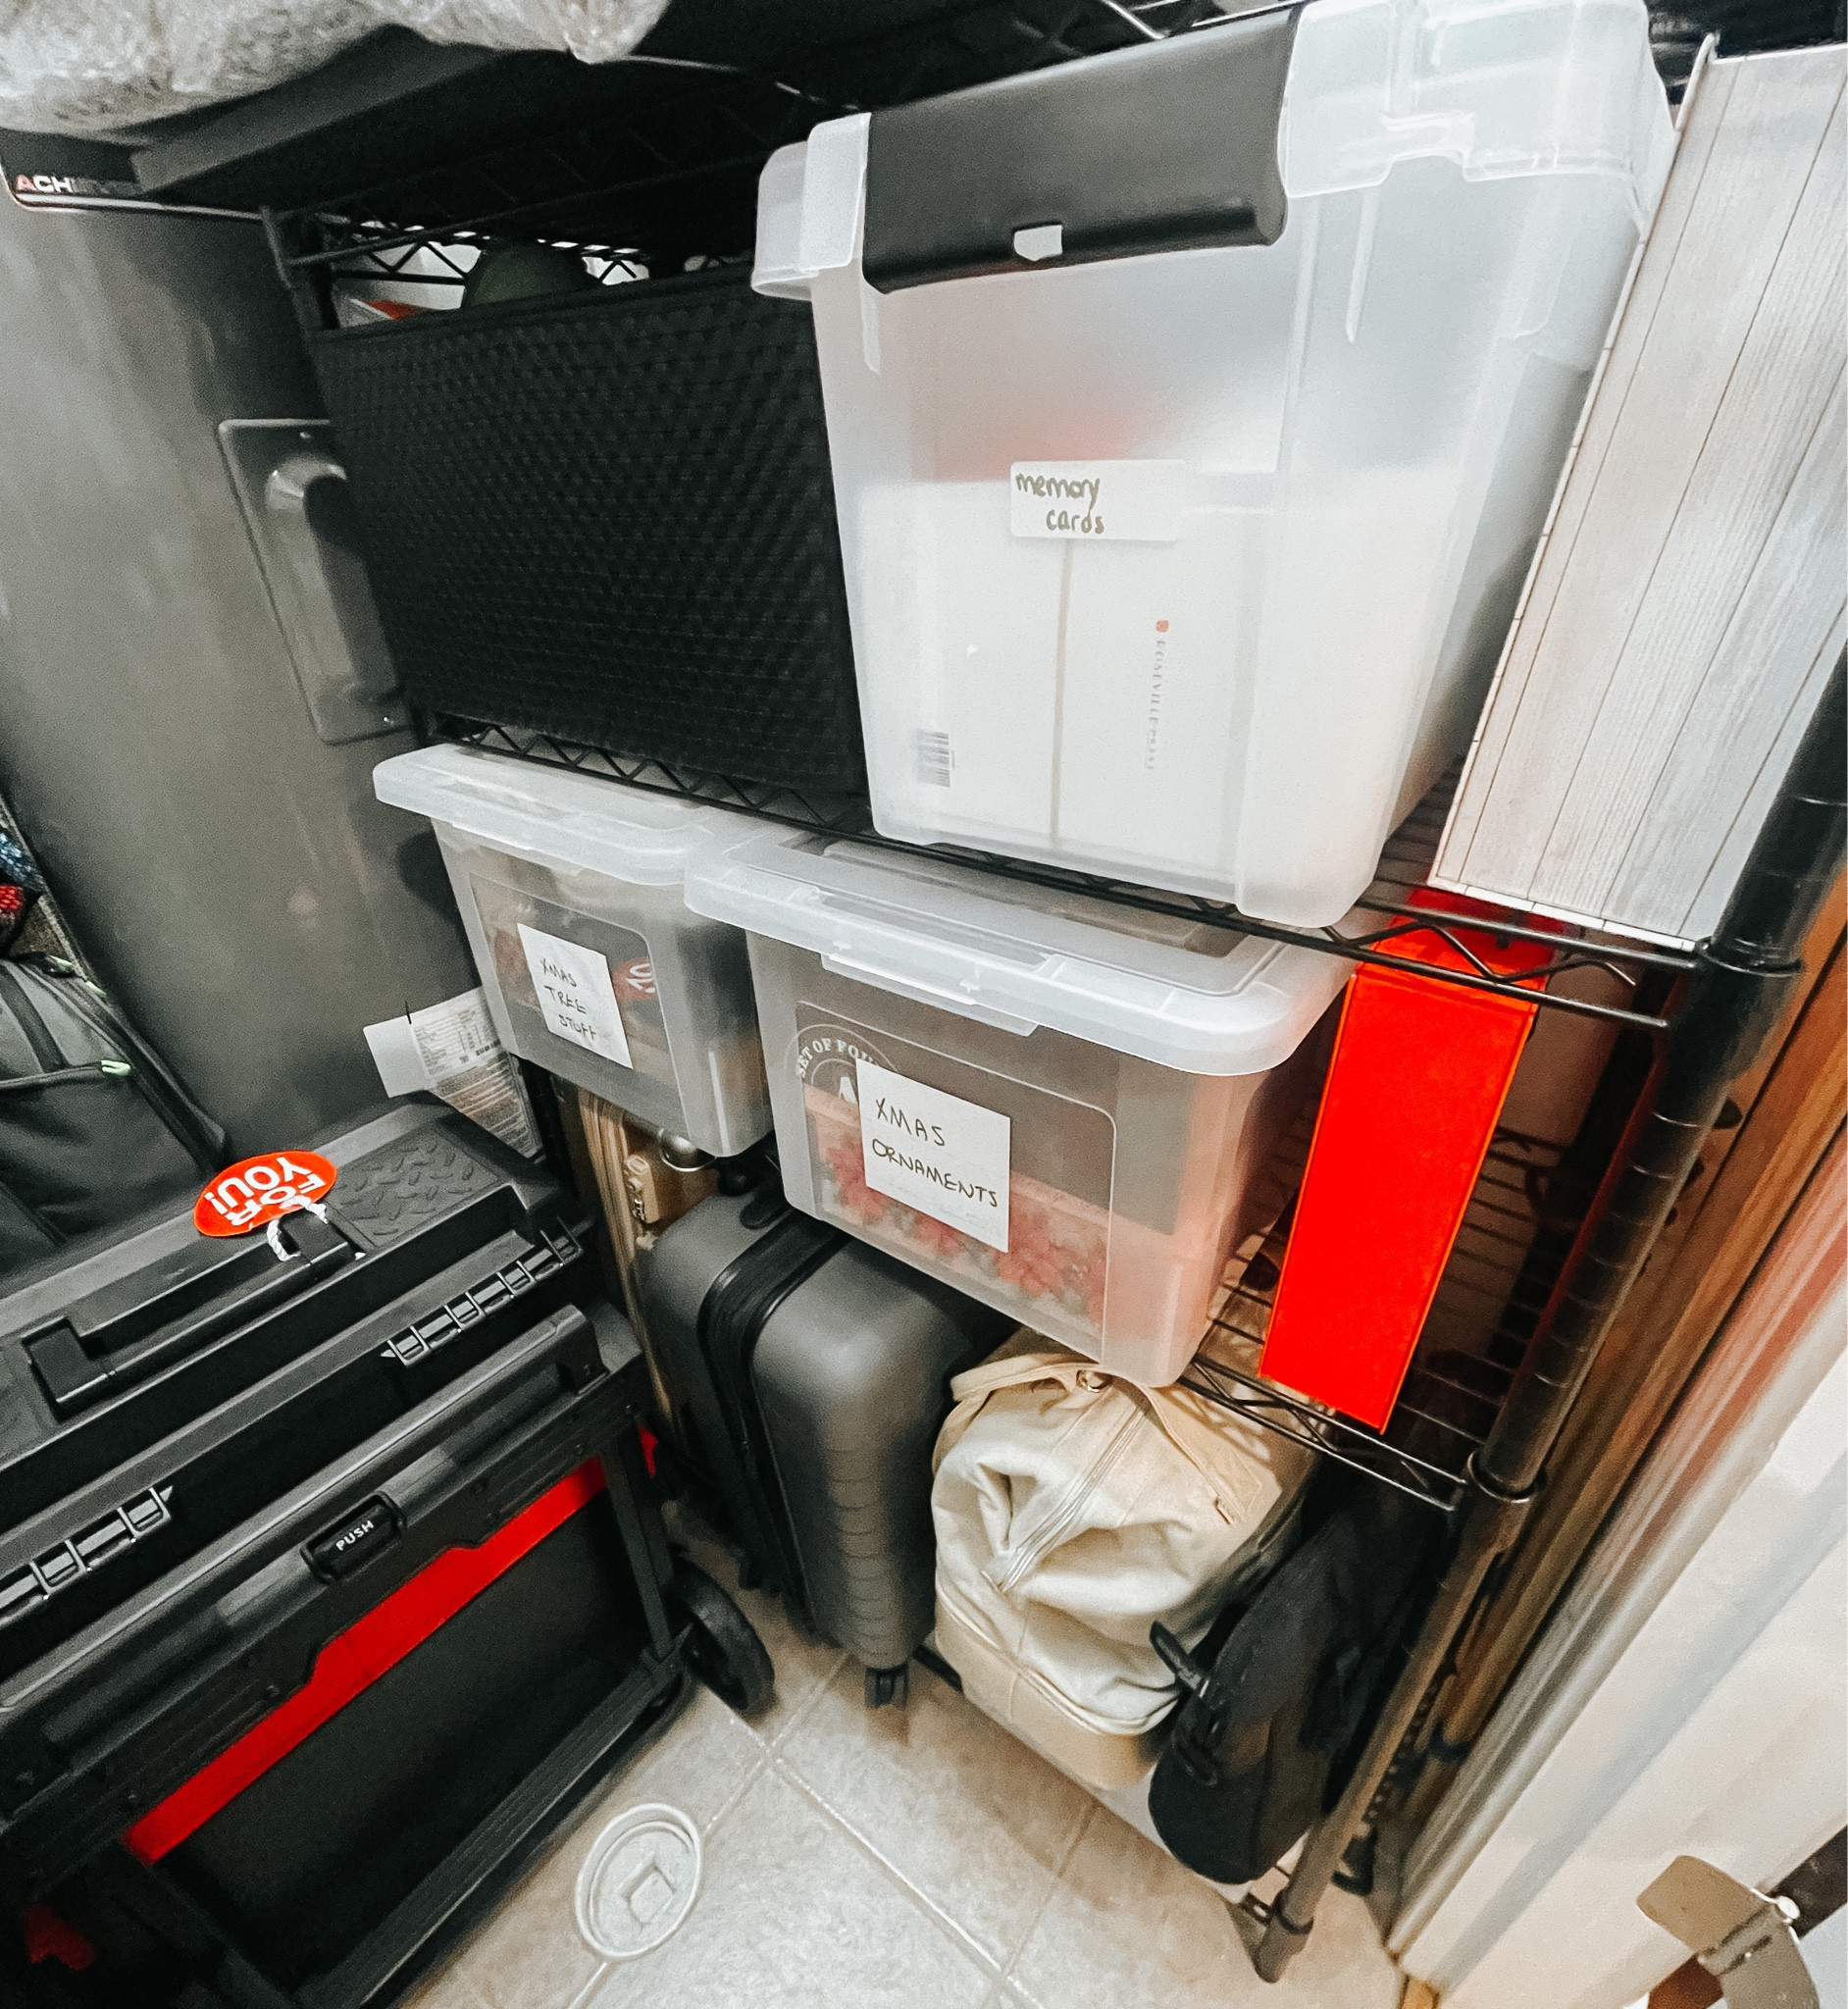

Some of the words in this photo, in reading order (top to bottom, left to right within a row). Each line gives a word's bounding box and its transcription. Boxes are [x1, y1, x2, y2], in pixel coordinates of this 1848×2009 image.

[1015, 473, 1101, 511] memory
[1046, 509, 1104, 534] cards
[540, 958, 578, 987] XMAS
[544, 985, 587, 1014] TREE
[558, 1013, 596, 1040] STUFF
[796, 1046, 814, 1078] SET
[812, 1038, 832, 1054] OF
[837, 1039, 880, 1068] FOU
[875, 1098, 946, 1146] XMAS
[203, 1157, 313, 1215] YOU!
[872, 1138, 999, 1208] ORNAMENTS
[225, 1173, 327, 1226] FOR
[335, 1520, 374, 1551] PUSH
